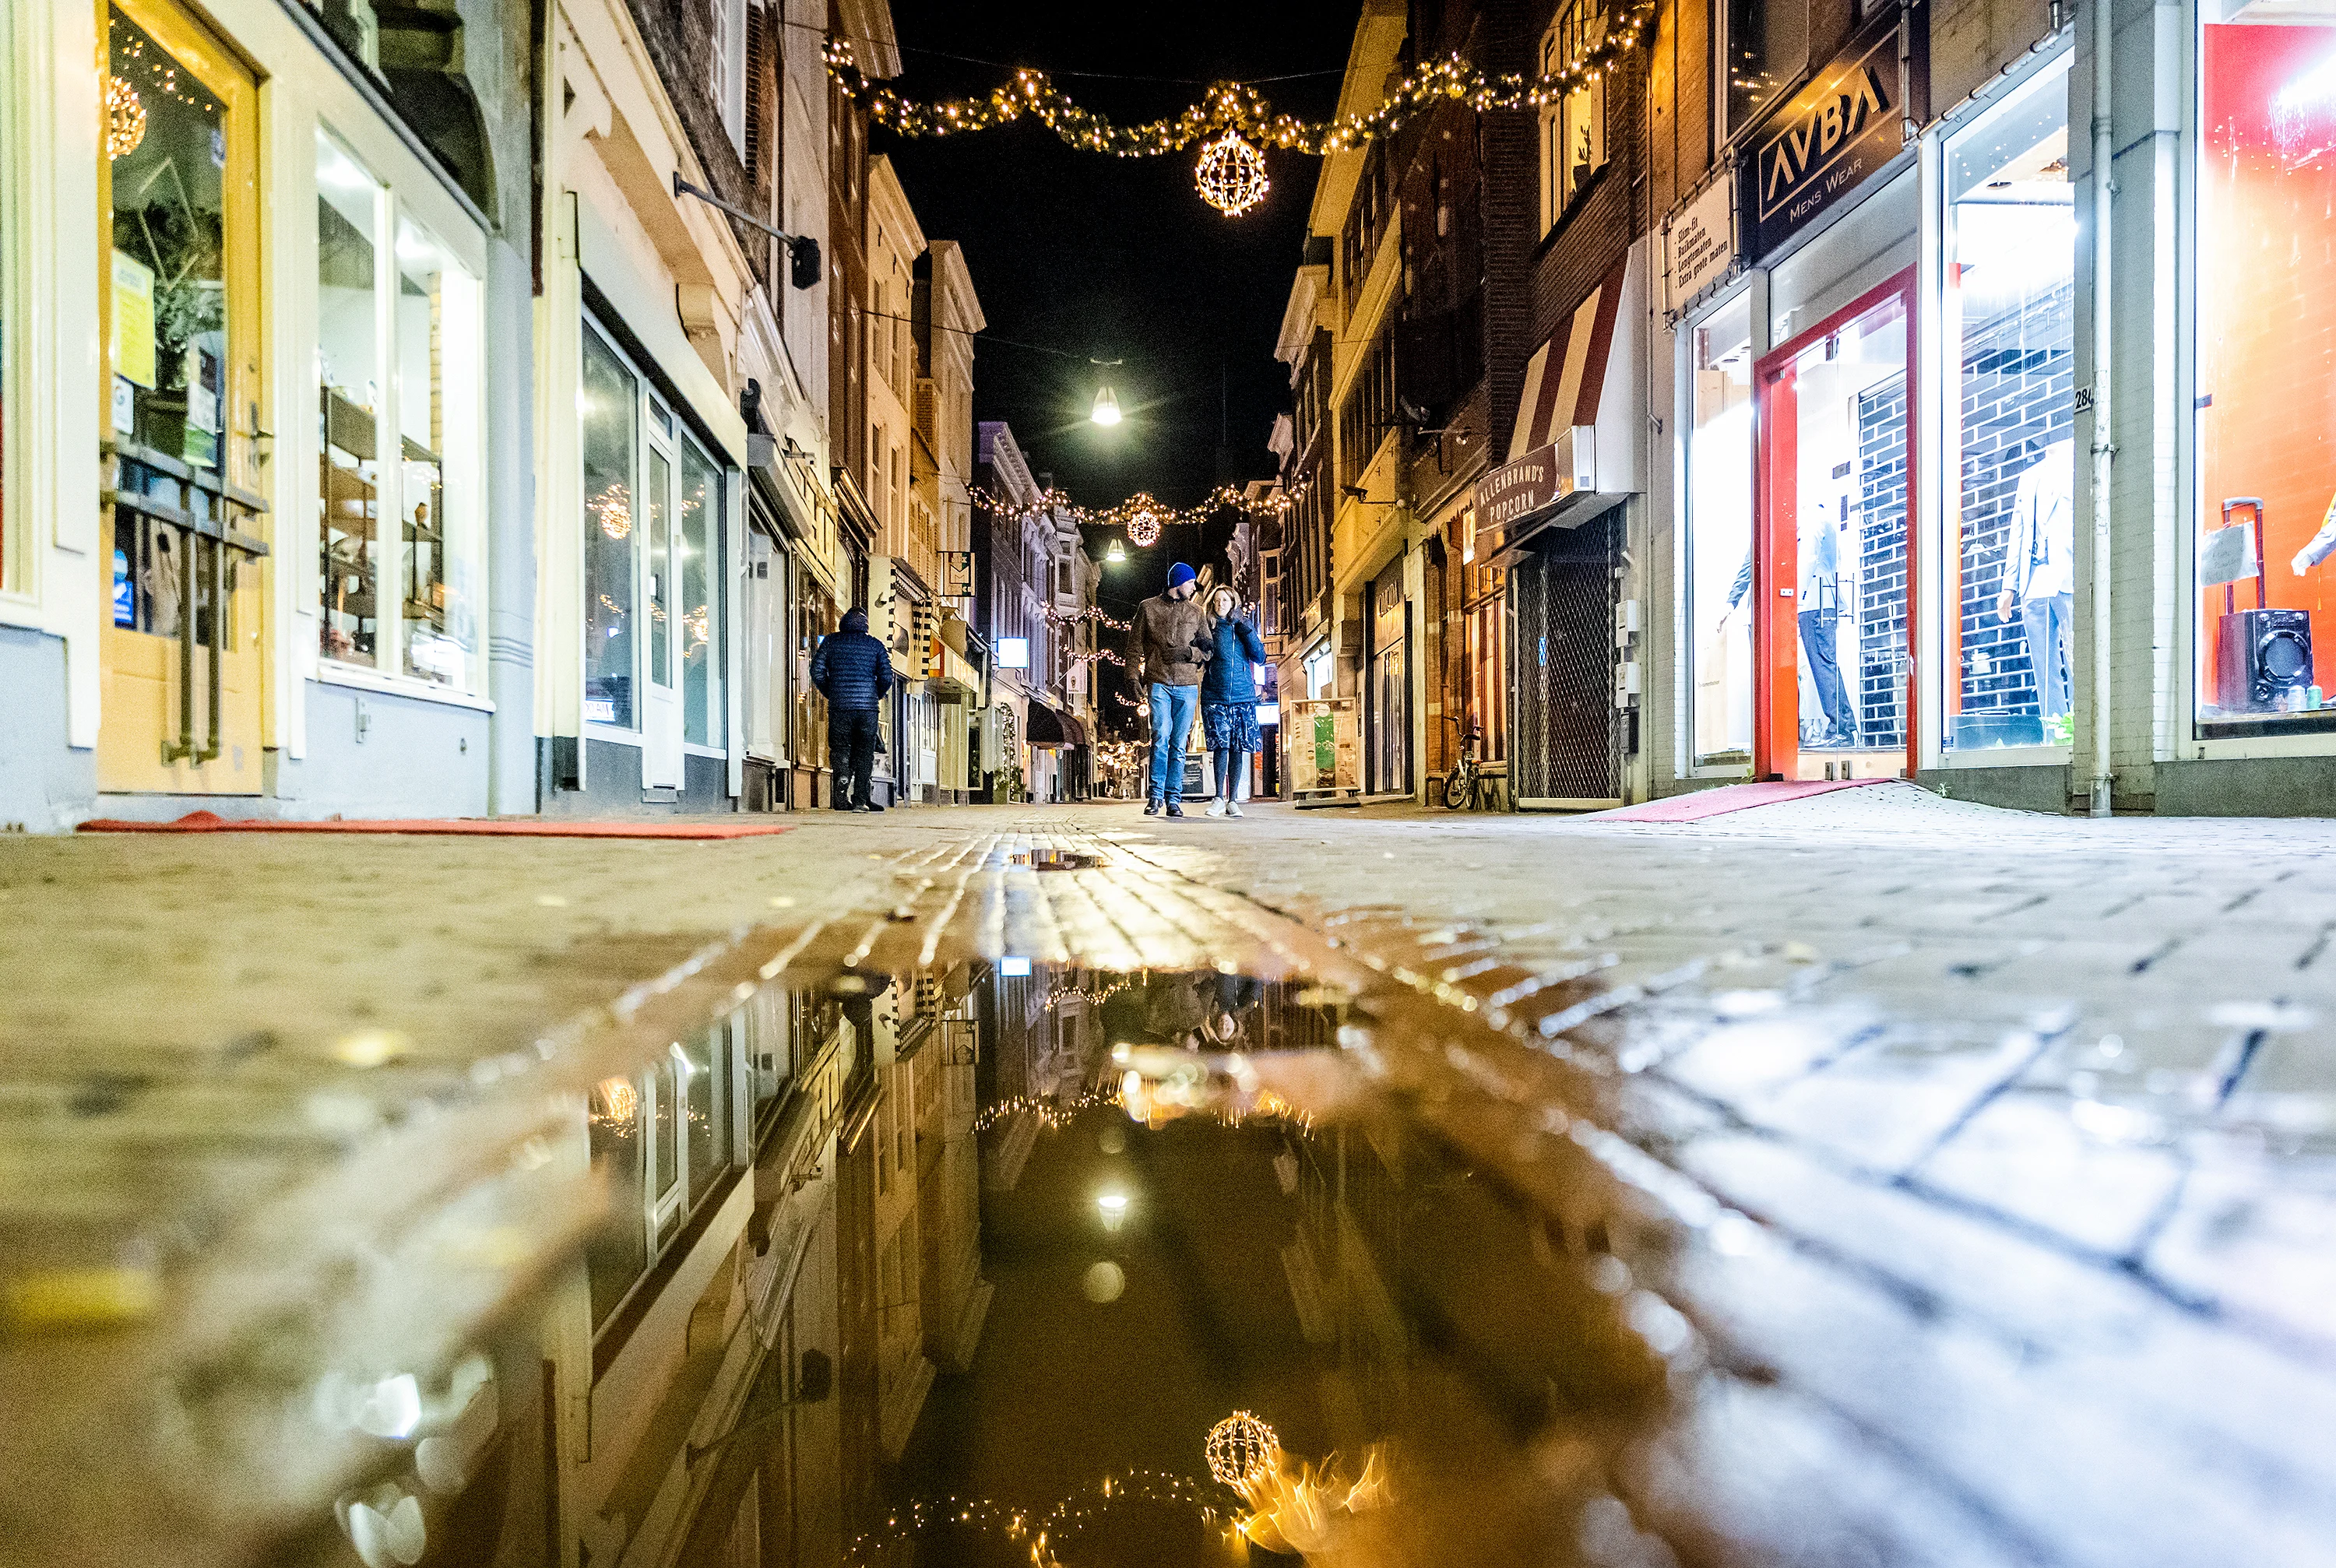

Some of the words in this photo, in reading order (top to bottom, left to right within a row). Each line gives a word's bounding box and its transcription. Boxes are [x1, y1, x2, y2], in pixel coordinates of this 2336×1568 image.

[1768, 67, 1880, 201] AVBA
[1678, 227, 1706, 258] Buikmaten
[1678, 237, 1712, 272] Lengtematen
[1679, 270, 1691, 288] Extra
[1694, 257, 1708, 279] grote
[1709, 241, 1728, 262] maten
[1480, 466, 1544, 507] ALLENBRAND'S
[1490, 489, 1534, 522] POPCORN
